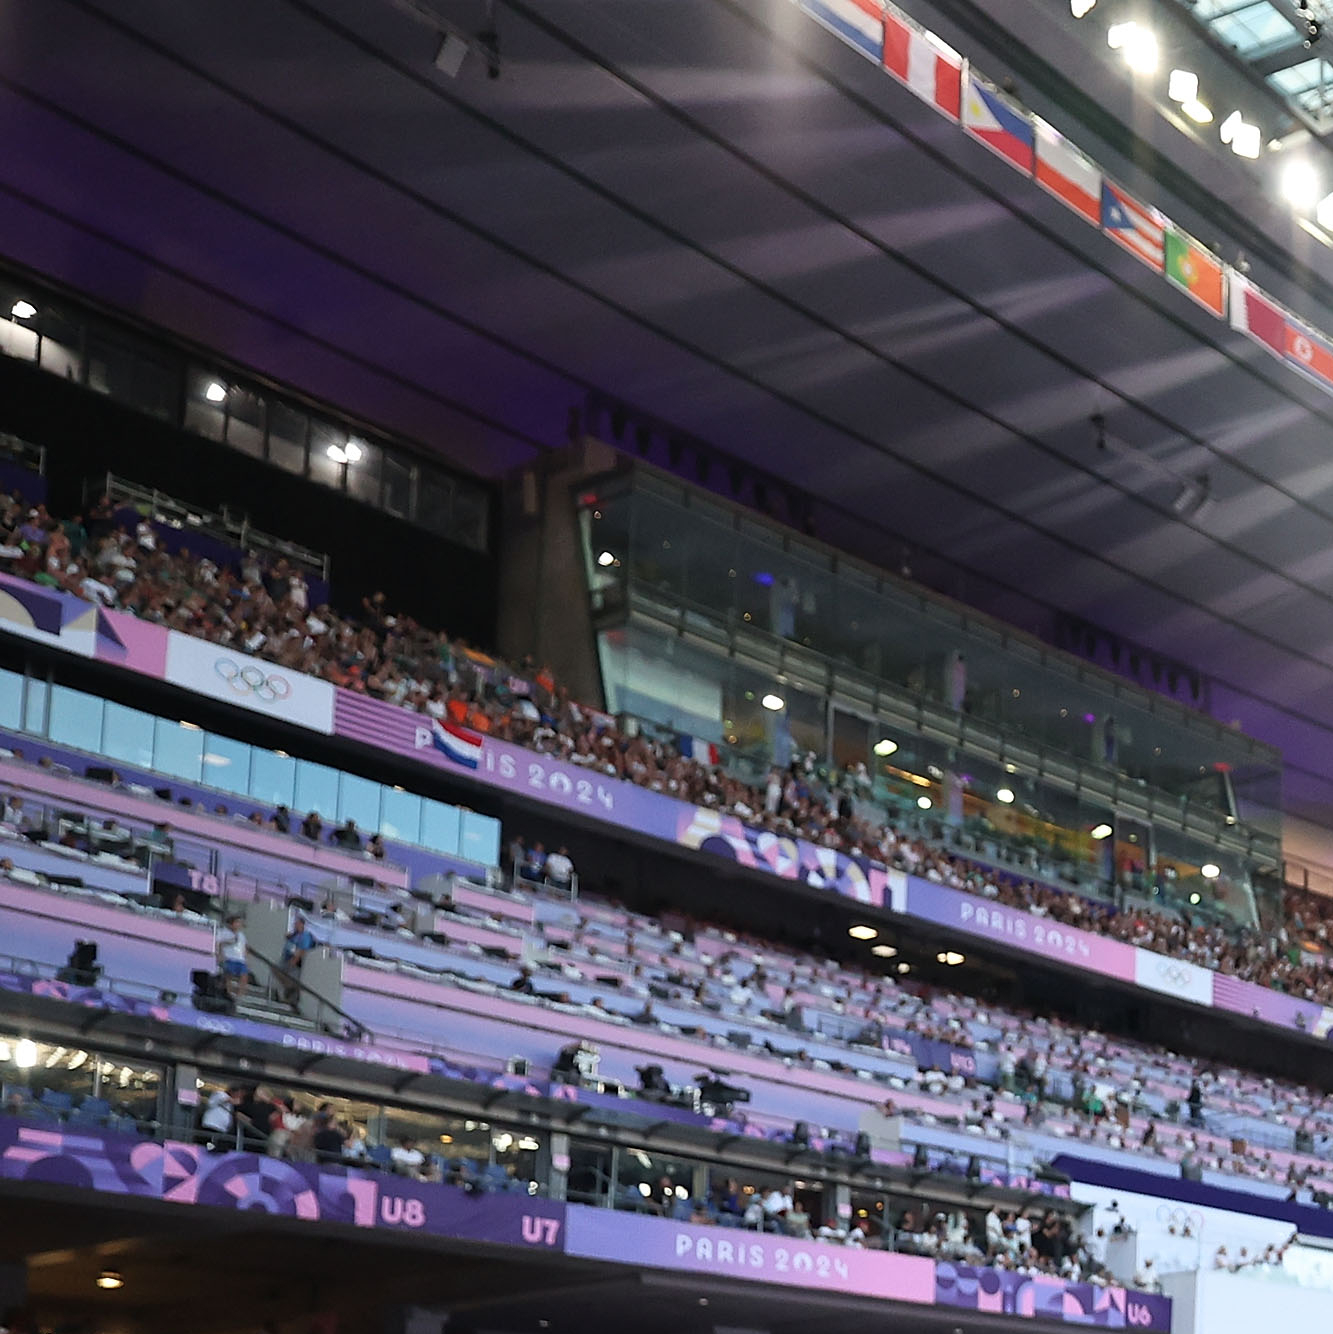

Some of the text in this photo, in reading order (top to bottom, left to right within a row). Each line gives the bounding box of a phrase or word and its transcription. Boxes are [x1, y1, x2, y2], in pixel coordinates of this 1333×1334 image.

[528, 763, 614, 809] 2024
[961, 902, 1027, 939] PARIS
[381, 1196, 426, 1227] U8
[522, 1215, 560, 1245] U7
[676, 1233, 848, 1280] PARIS 2024
[1128, 1303, 1152, 1327] U6
